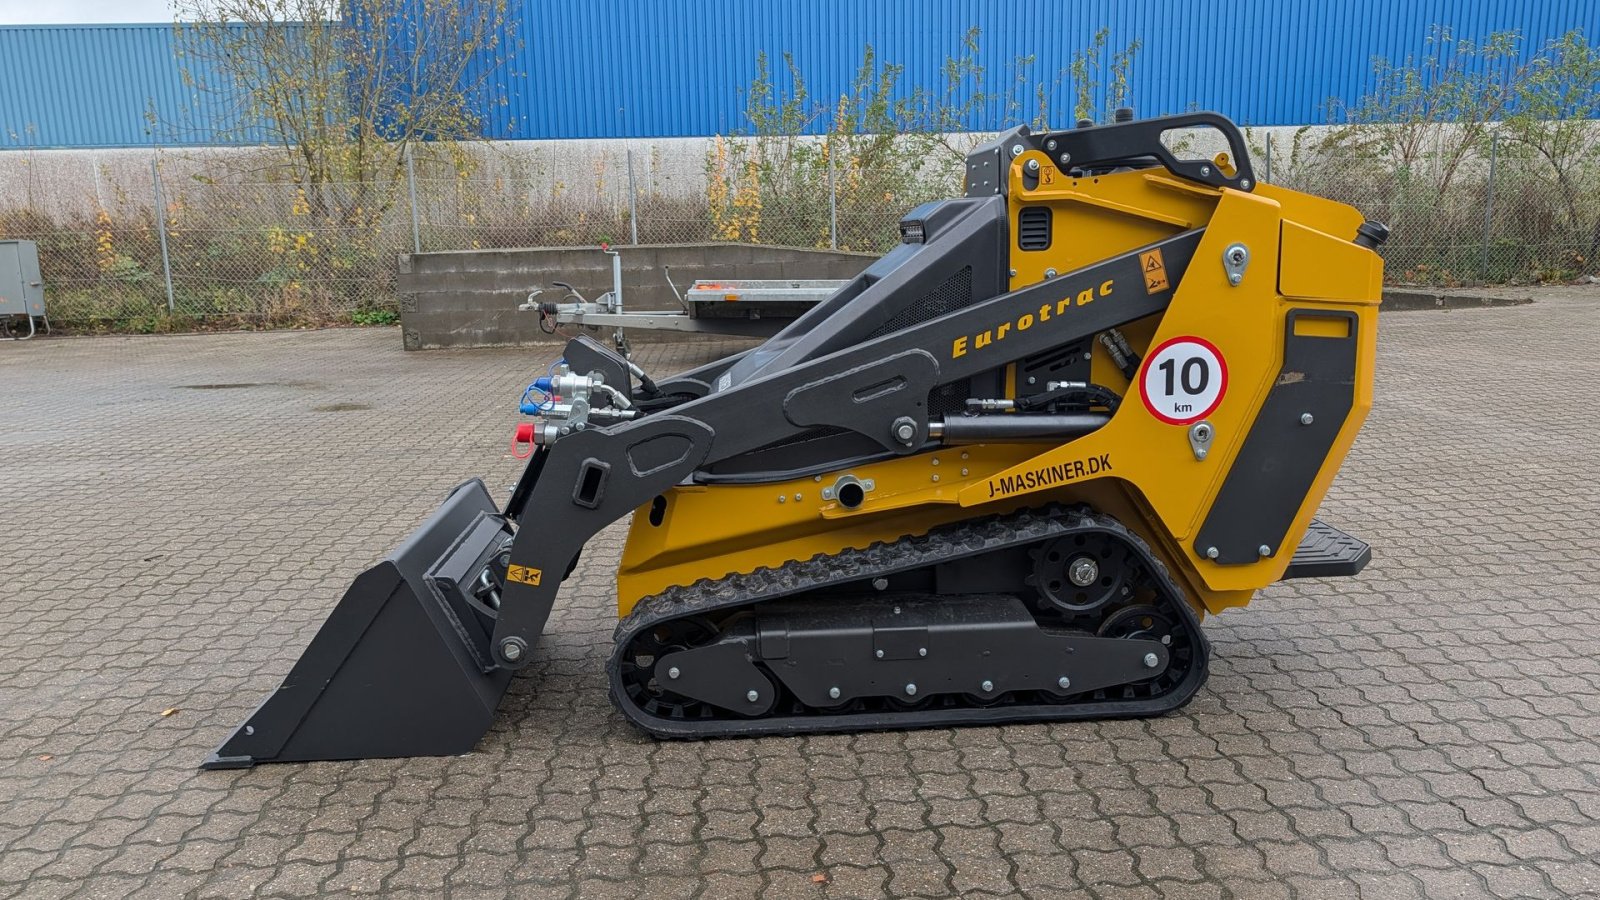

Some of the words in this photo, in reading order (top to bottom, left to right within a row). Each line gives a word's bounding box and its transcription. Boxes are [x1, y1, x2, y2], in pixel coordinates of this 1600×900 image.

[952, 279, 1114, 359] Eurotrac
[1159, 356, 1209, 396] 10
[1174, 402, 1192, 413] km
[988, 453, 1112, 497] J-MASKINER.DK
